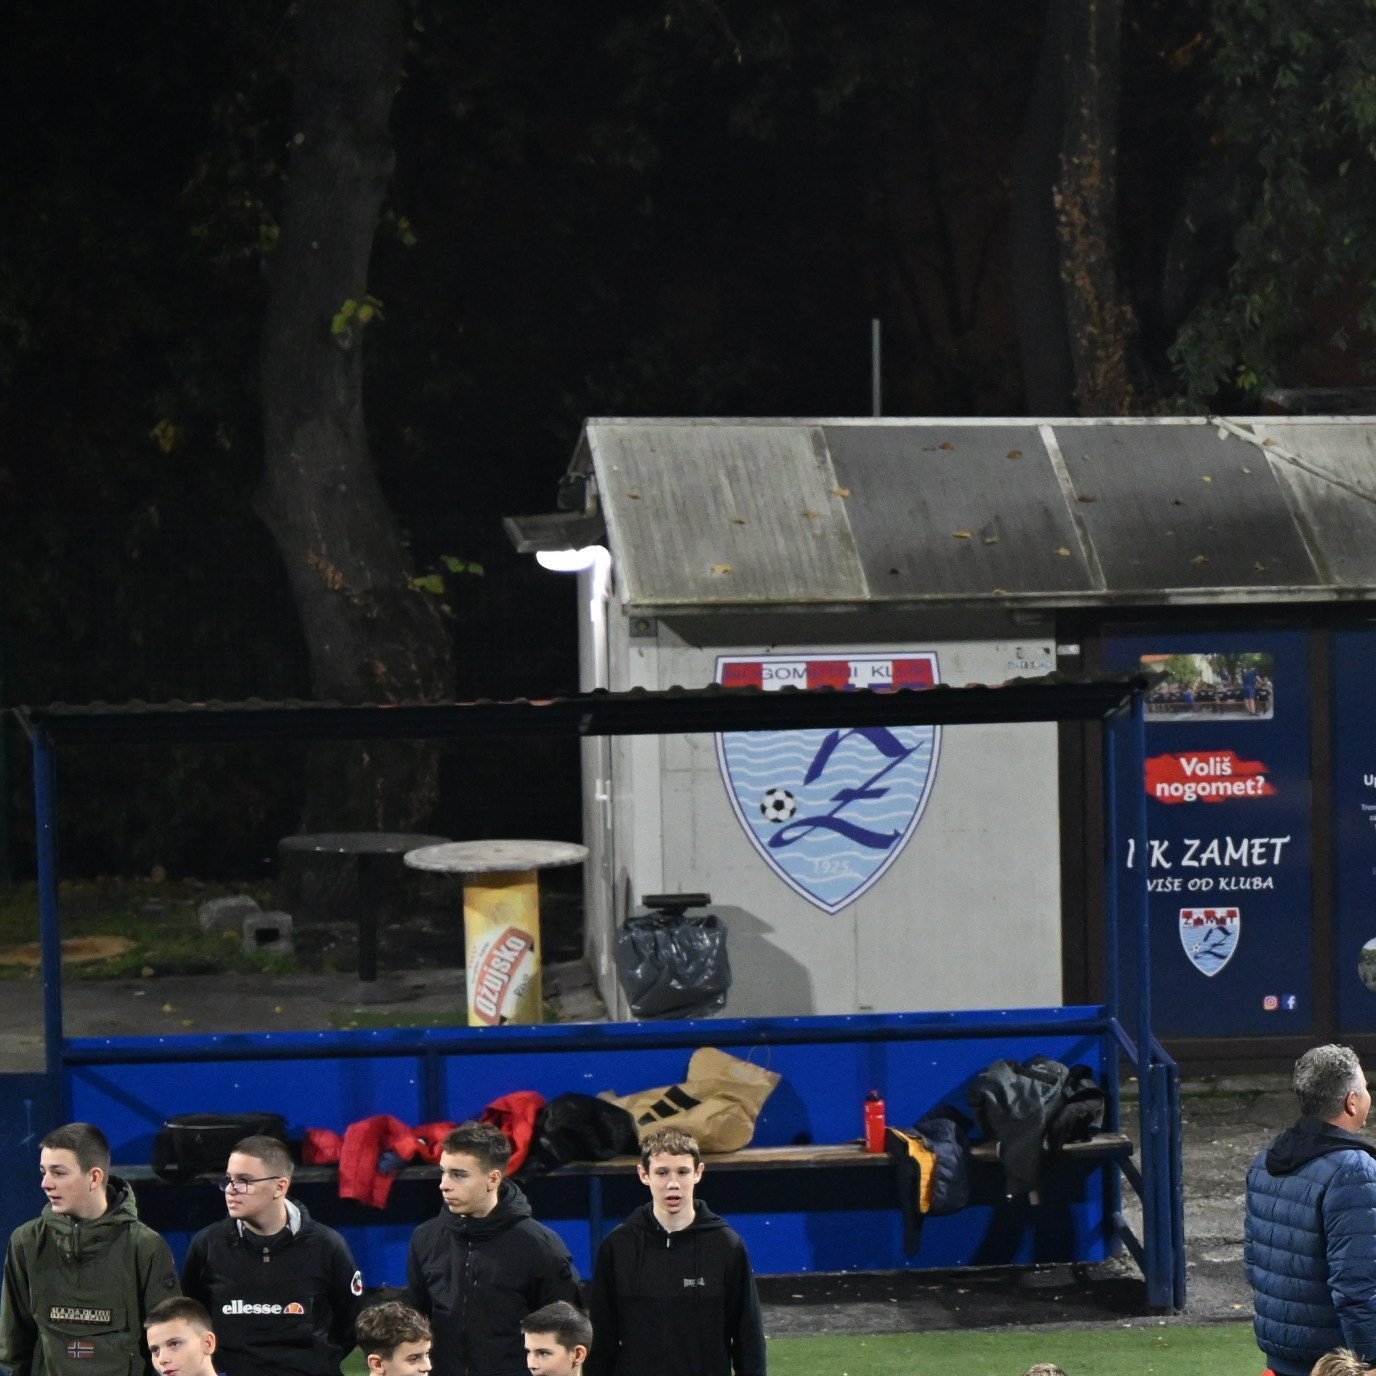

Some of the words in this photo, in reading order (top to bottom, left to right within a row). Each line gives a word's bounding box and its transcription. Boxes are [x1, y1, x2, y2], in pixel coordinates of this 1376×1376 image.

[1180, 757, 1232, 776] Voliš
[1156, 776, 1265, 802] nogomet?
[1181, 835, 1291, 868] ZAMET
[1147, 877, 1183, 892] VIŠE
[1187, 878, 1213, 891] OD
[1218, 876, 1274, 890] KLUBA
[222, 1300, 282, 1315] ellesse
